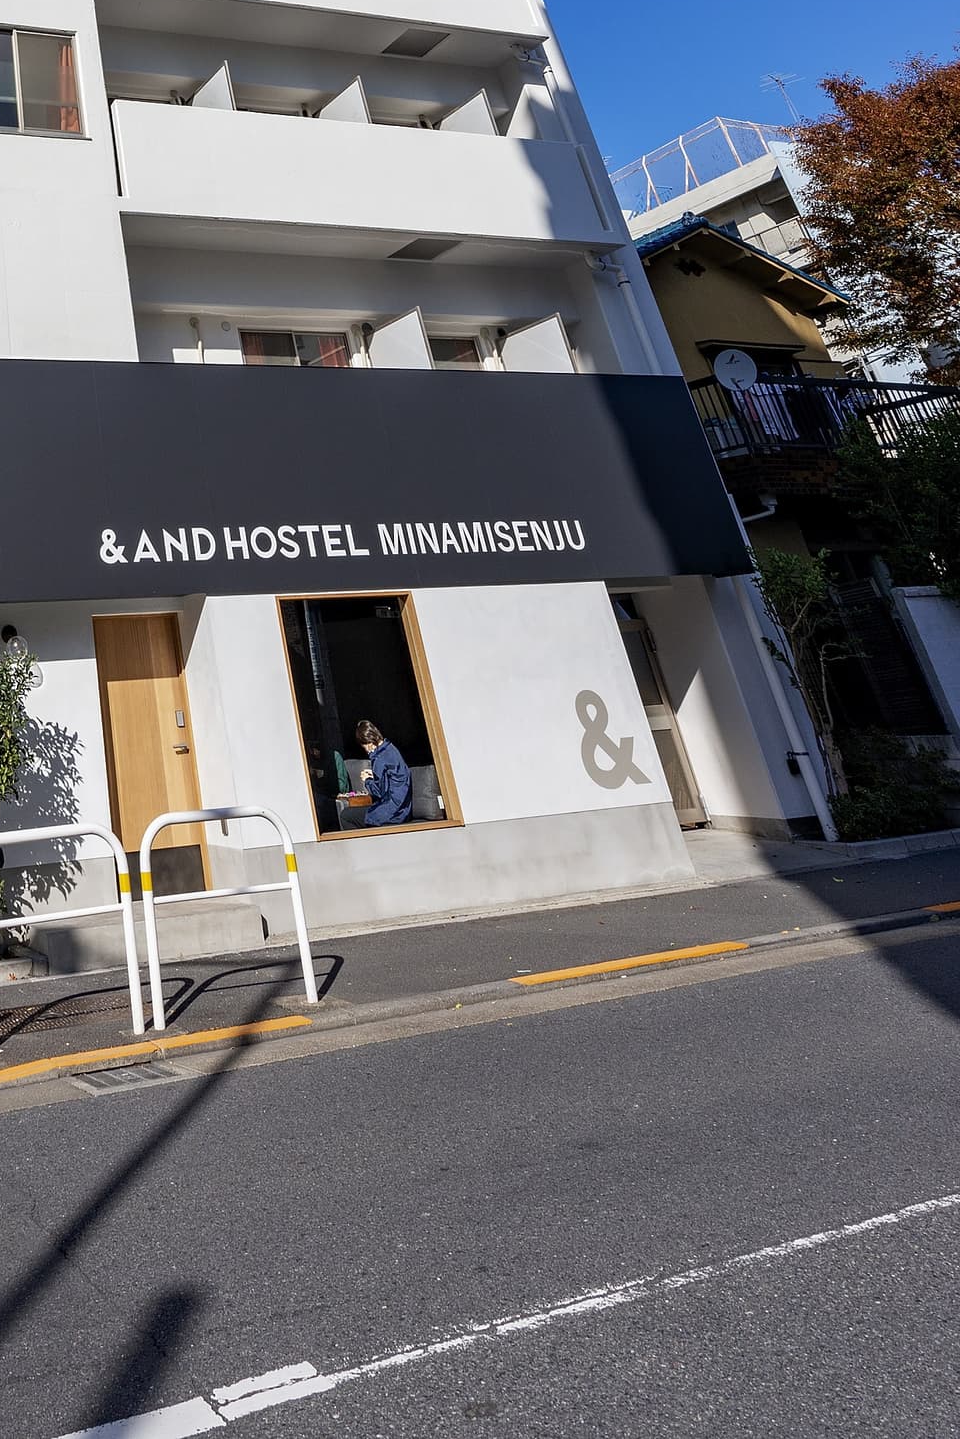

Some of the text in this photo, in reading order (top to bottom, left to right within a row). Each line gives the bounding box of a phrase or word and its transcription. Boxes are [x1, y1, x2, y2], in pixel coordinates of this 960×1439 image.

[99, 519, 586, 565] & AND HOSTEL MINAMISENJU
[574, 688, 653, 790] &
